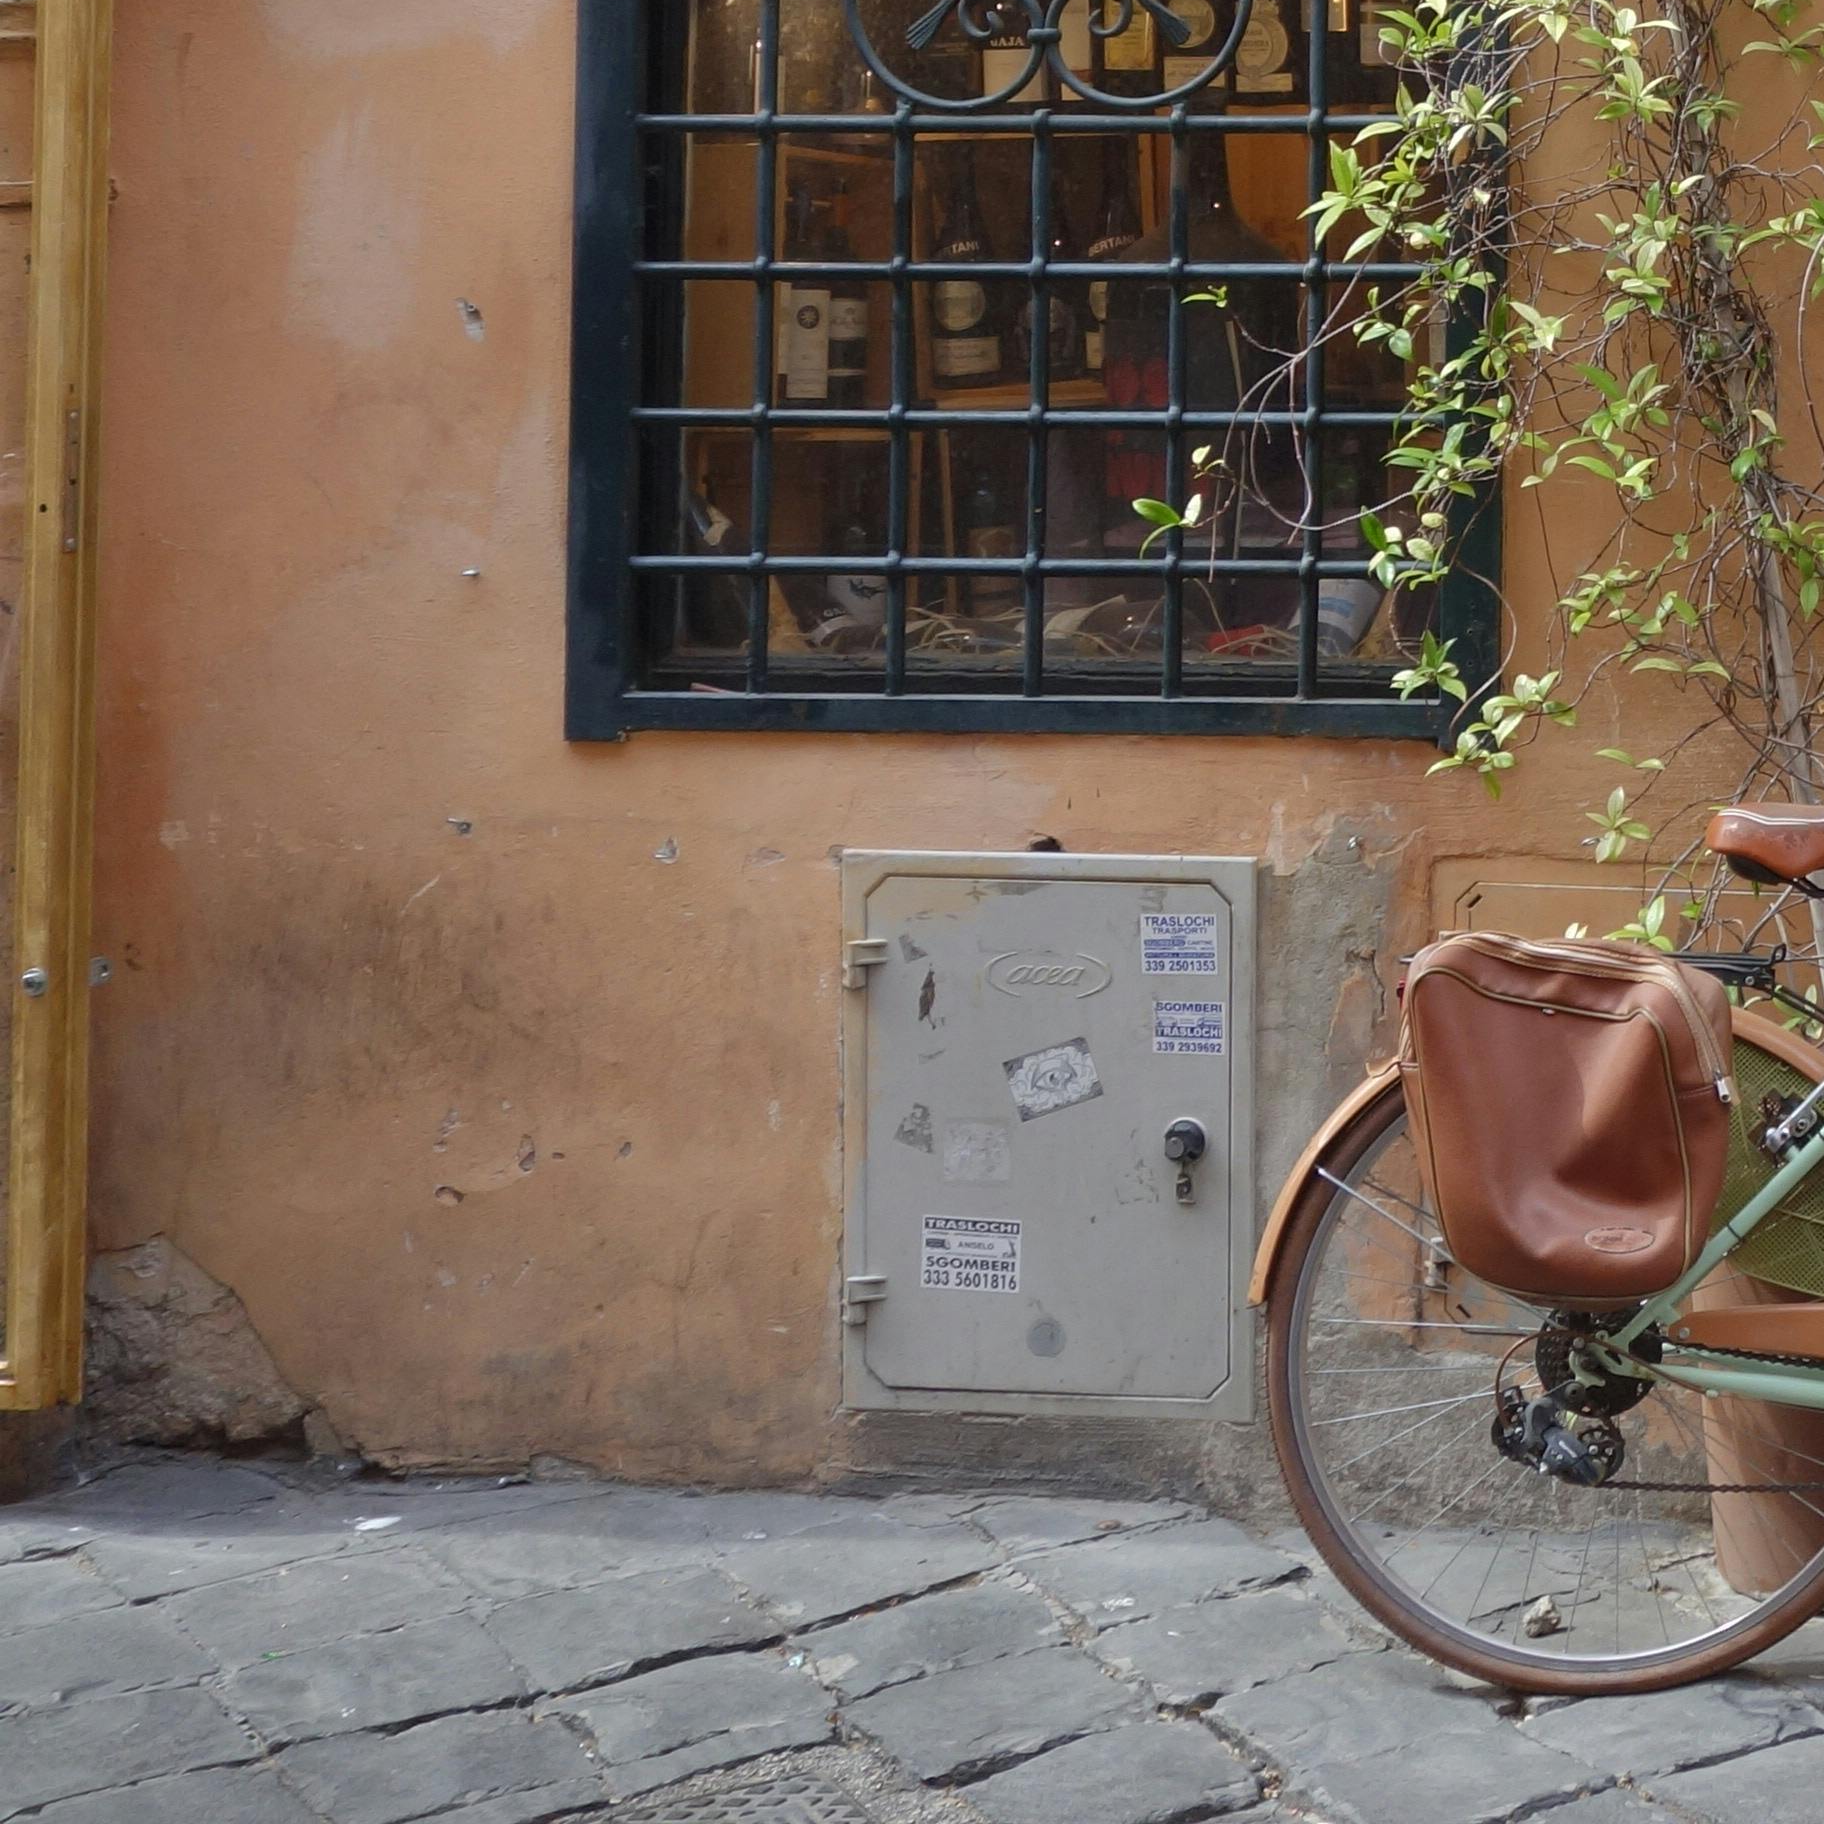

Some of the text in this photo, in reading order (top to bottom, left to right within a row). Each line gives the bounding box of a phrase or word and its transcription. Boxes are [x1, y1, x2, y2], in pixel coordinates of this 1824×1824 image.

[1144, 916, 1215, 926] TRASLOCHI
[1145, 960, 1216, 971] 339 2501353
[1007, 964, 1085, 986] acea
[1156, 1002, 1222, 1013] SGOMBERI
[1157, 1026, 1222, 1037] TRASLOCHI
[1156, 1041, 1175, 1051] 339
[925, 1218, 1018, 1234] TRASLOCHI
[926, 1256, 1016, 1273] SGOMBERI
[924, 1269, 1017, 1290] 333 5601816
